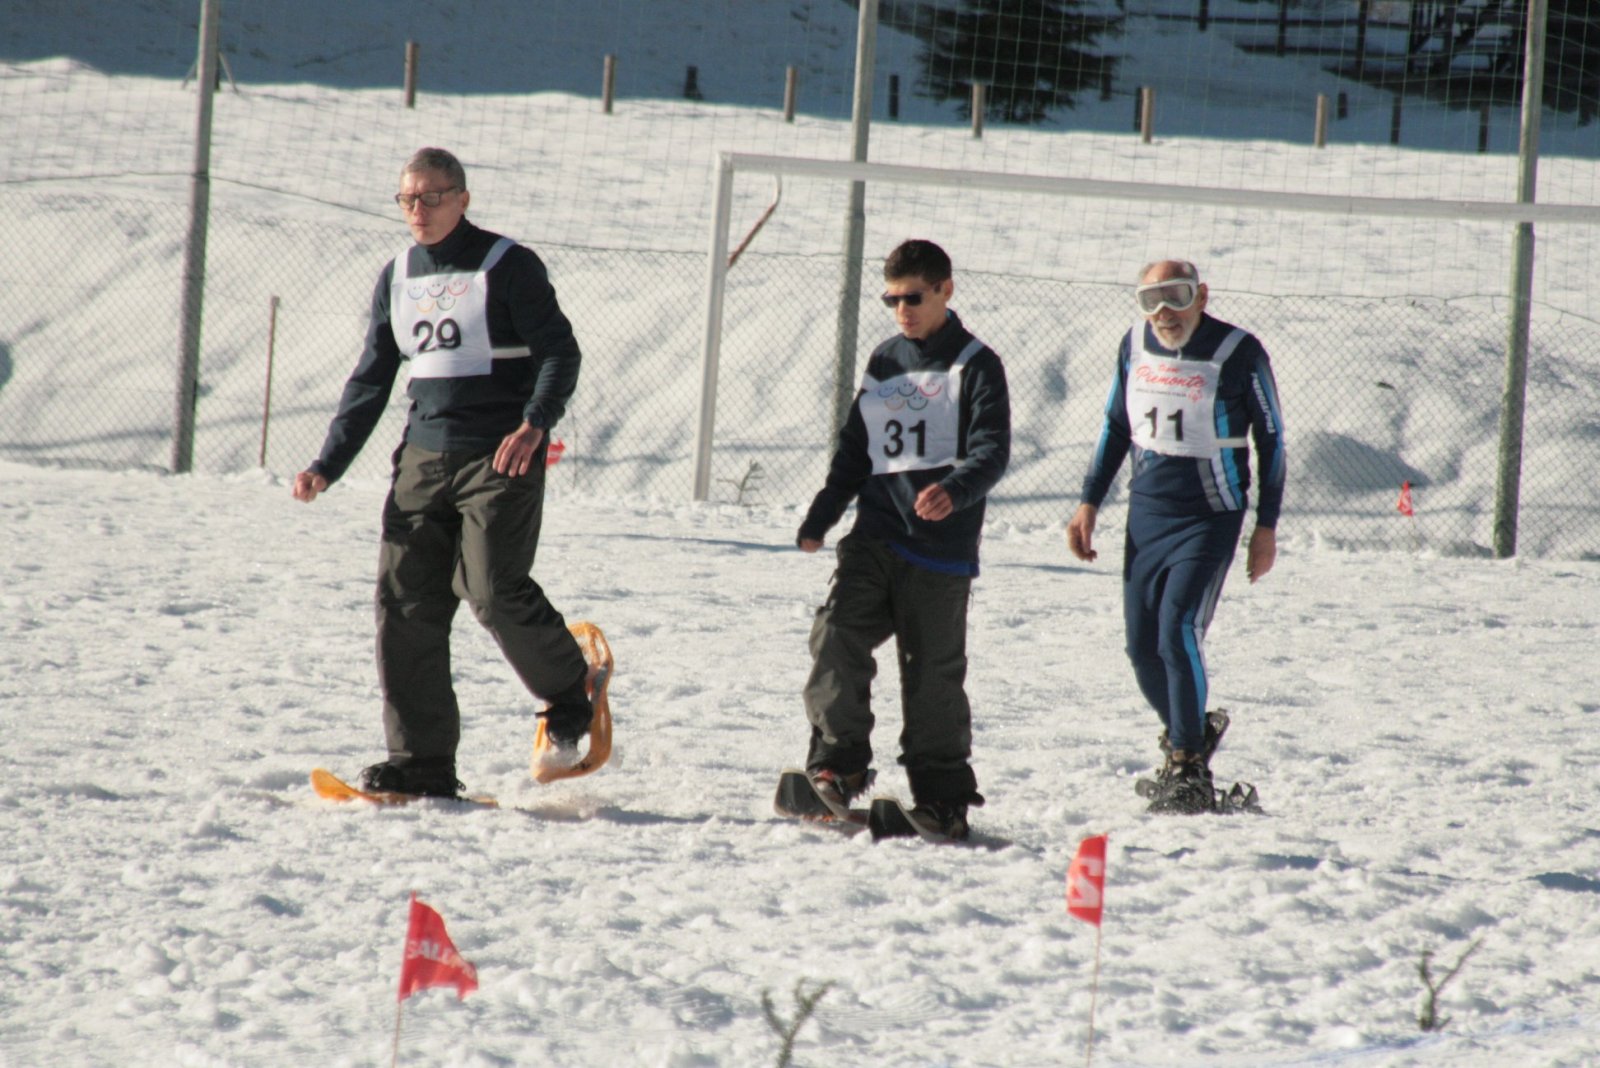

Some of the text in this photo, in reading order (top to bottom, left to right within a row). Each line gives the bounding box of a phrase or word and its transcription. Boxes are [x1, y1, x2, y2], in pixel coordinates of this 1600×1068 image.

[412, 317, 462, 353] 29
[883, 419, 926, 459] 31
[1144, 406, 1184, 442] 11
